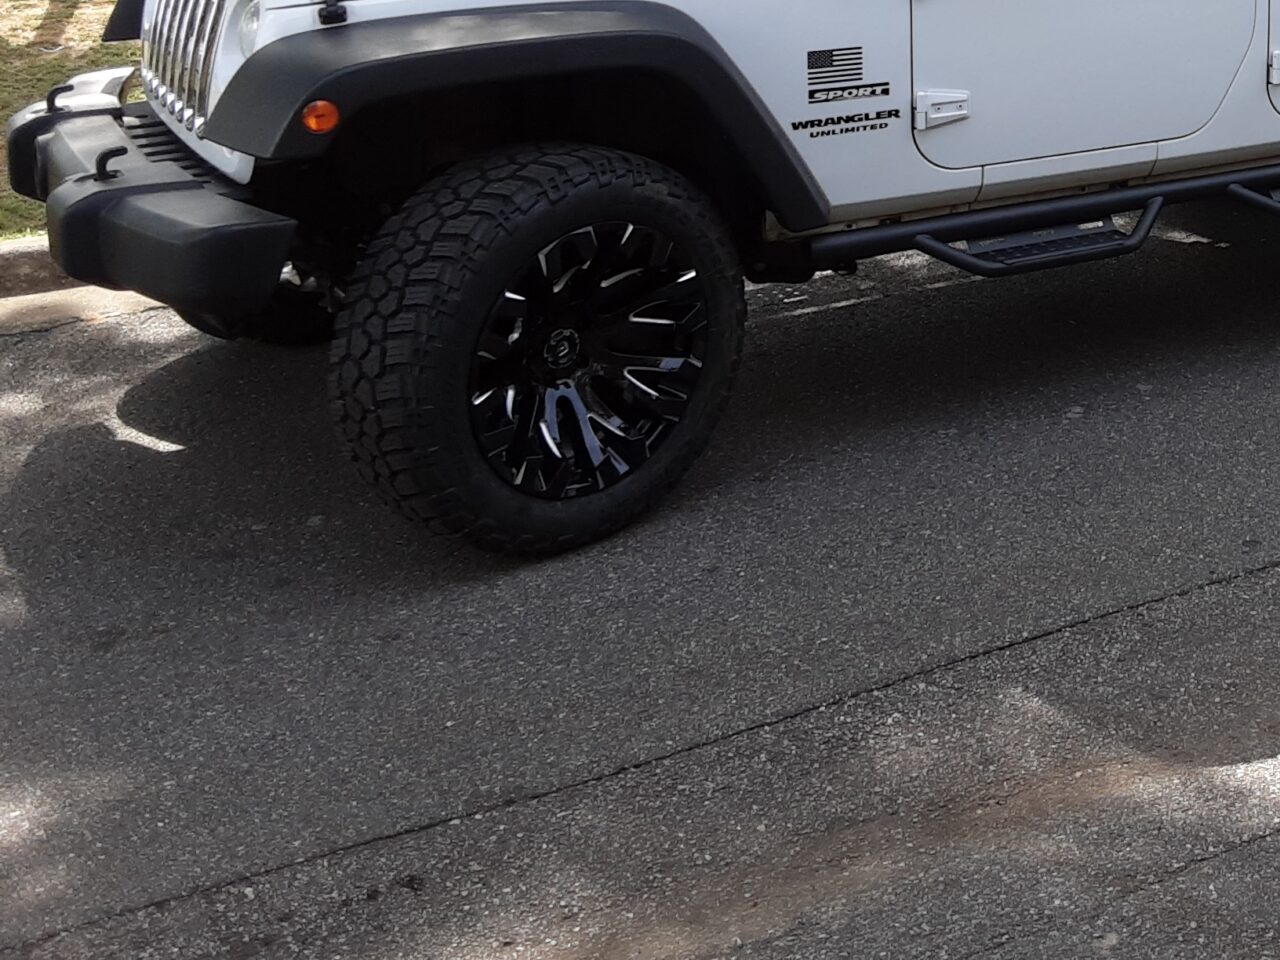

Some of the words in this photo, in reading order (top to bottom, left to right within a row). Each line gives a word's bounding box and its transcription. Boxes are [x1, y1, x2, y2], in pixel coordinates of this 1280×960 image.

[813, 86, 885, 100] SPORT
[791, 109, 901, 131] WRANGLER
[809, 123, 888, 138] UNLIMITED
